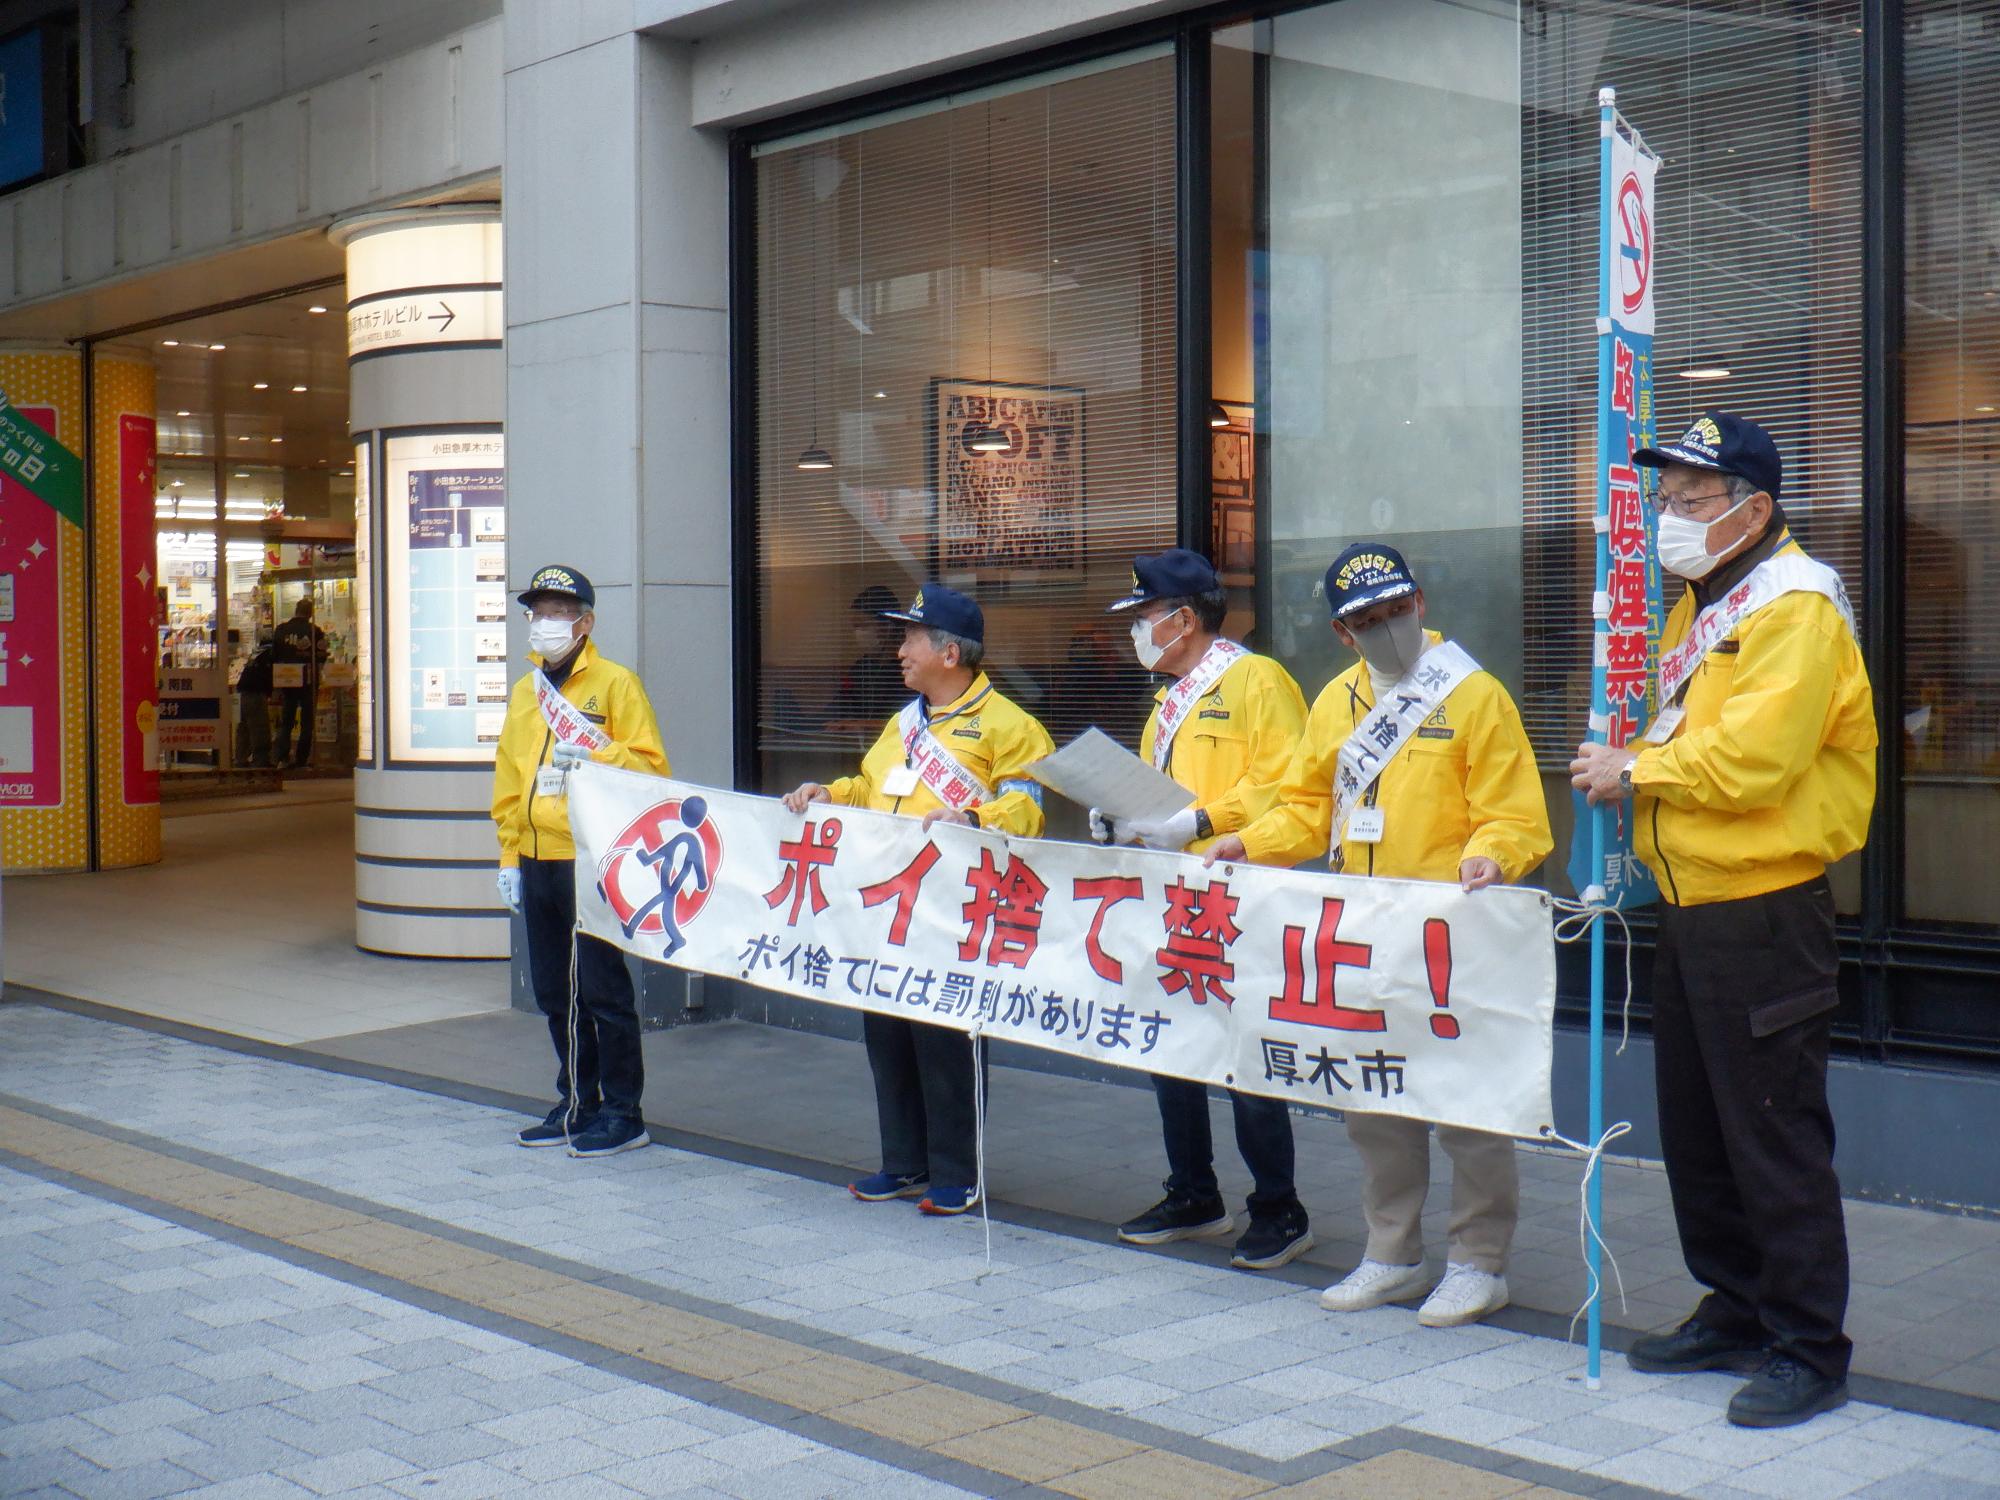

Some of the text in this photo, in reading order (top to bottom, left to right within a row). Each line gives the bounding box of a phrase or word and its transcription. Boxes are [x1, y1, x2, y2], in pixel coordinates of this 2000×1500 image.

[1336, 554, 1396, 590] ATSUGI
[1353, 570, 1378, 585] CITY
[762, 817, 1460, 1040] ポイ捨て禁止！
[738, 934, 1172, 1055] ポイ捨てには罰則があります
[1261, 1037, 1408, 1098] 厚木市
